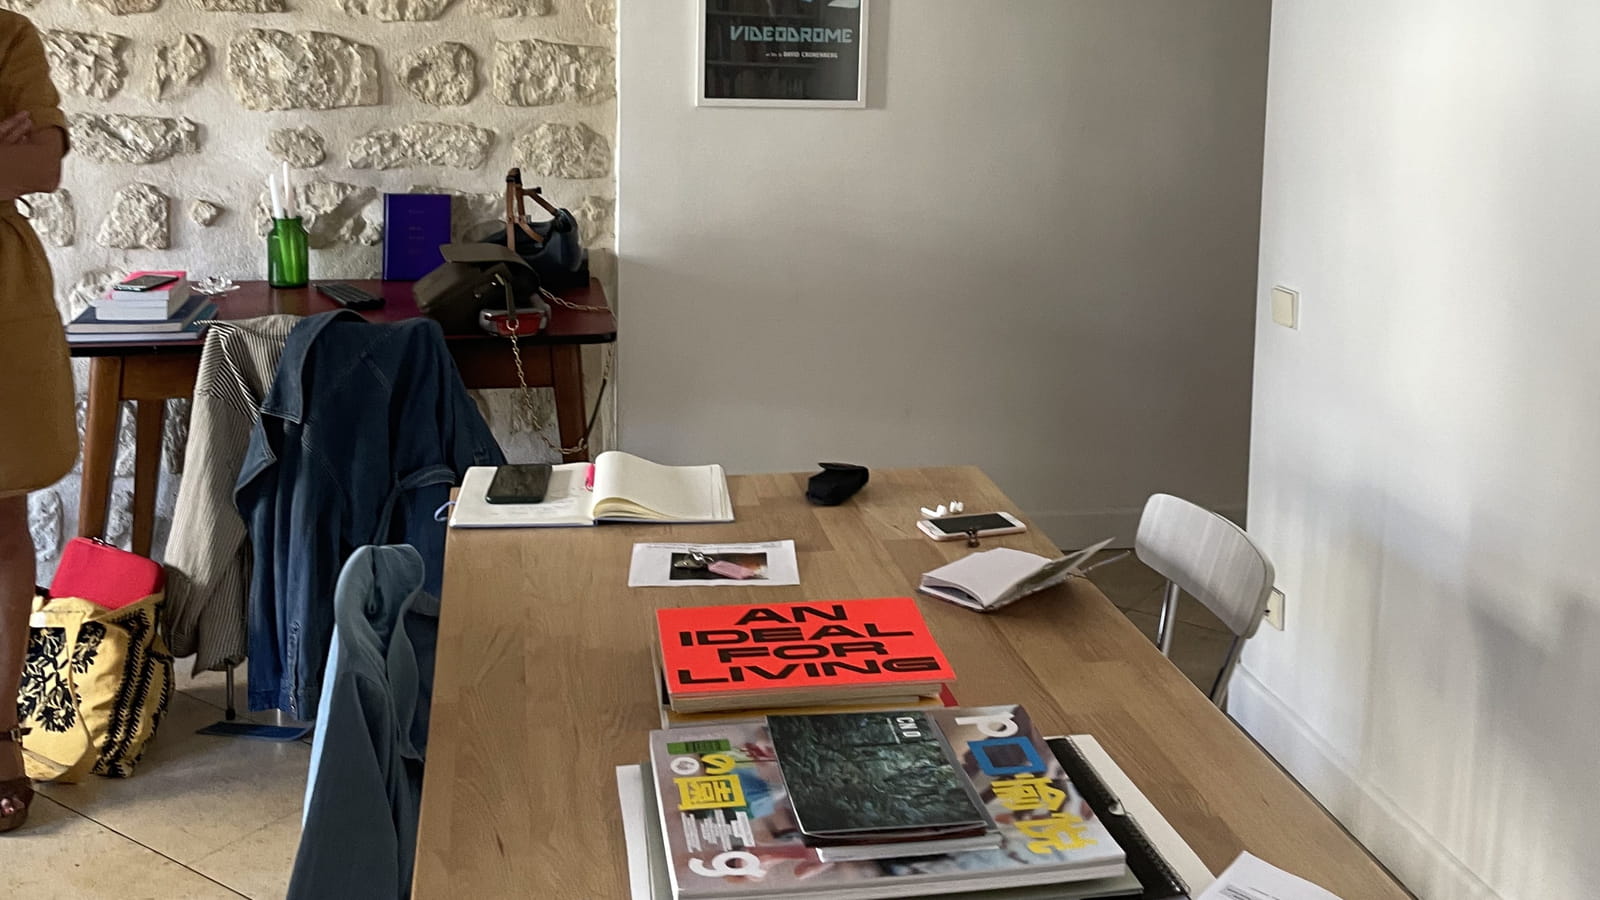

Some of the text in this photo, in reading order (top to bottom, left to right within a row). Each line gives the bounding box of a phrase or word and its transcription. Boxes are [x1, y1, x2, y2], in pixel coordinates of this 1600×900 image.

[730, 25, 853, 43] VIDEODROME
[735, 604, 848, 625] AN
[679, 623, 914, 646] IDEAL
[717, 641, 889, 663] FOR
[677, 656, 941, 684] LIVING
